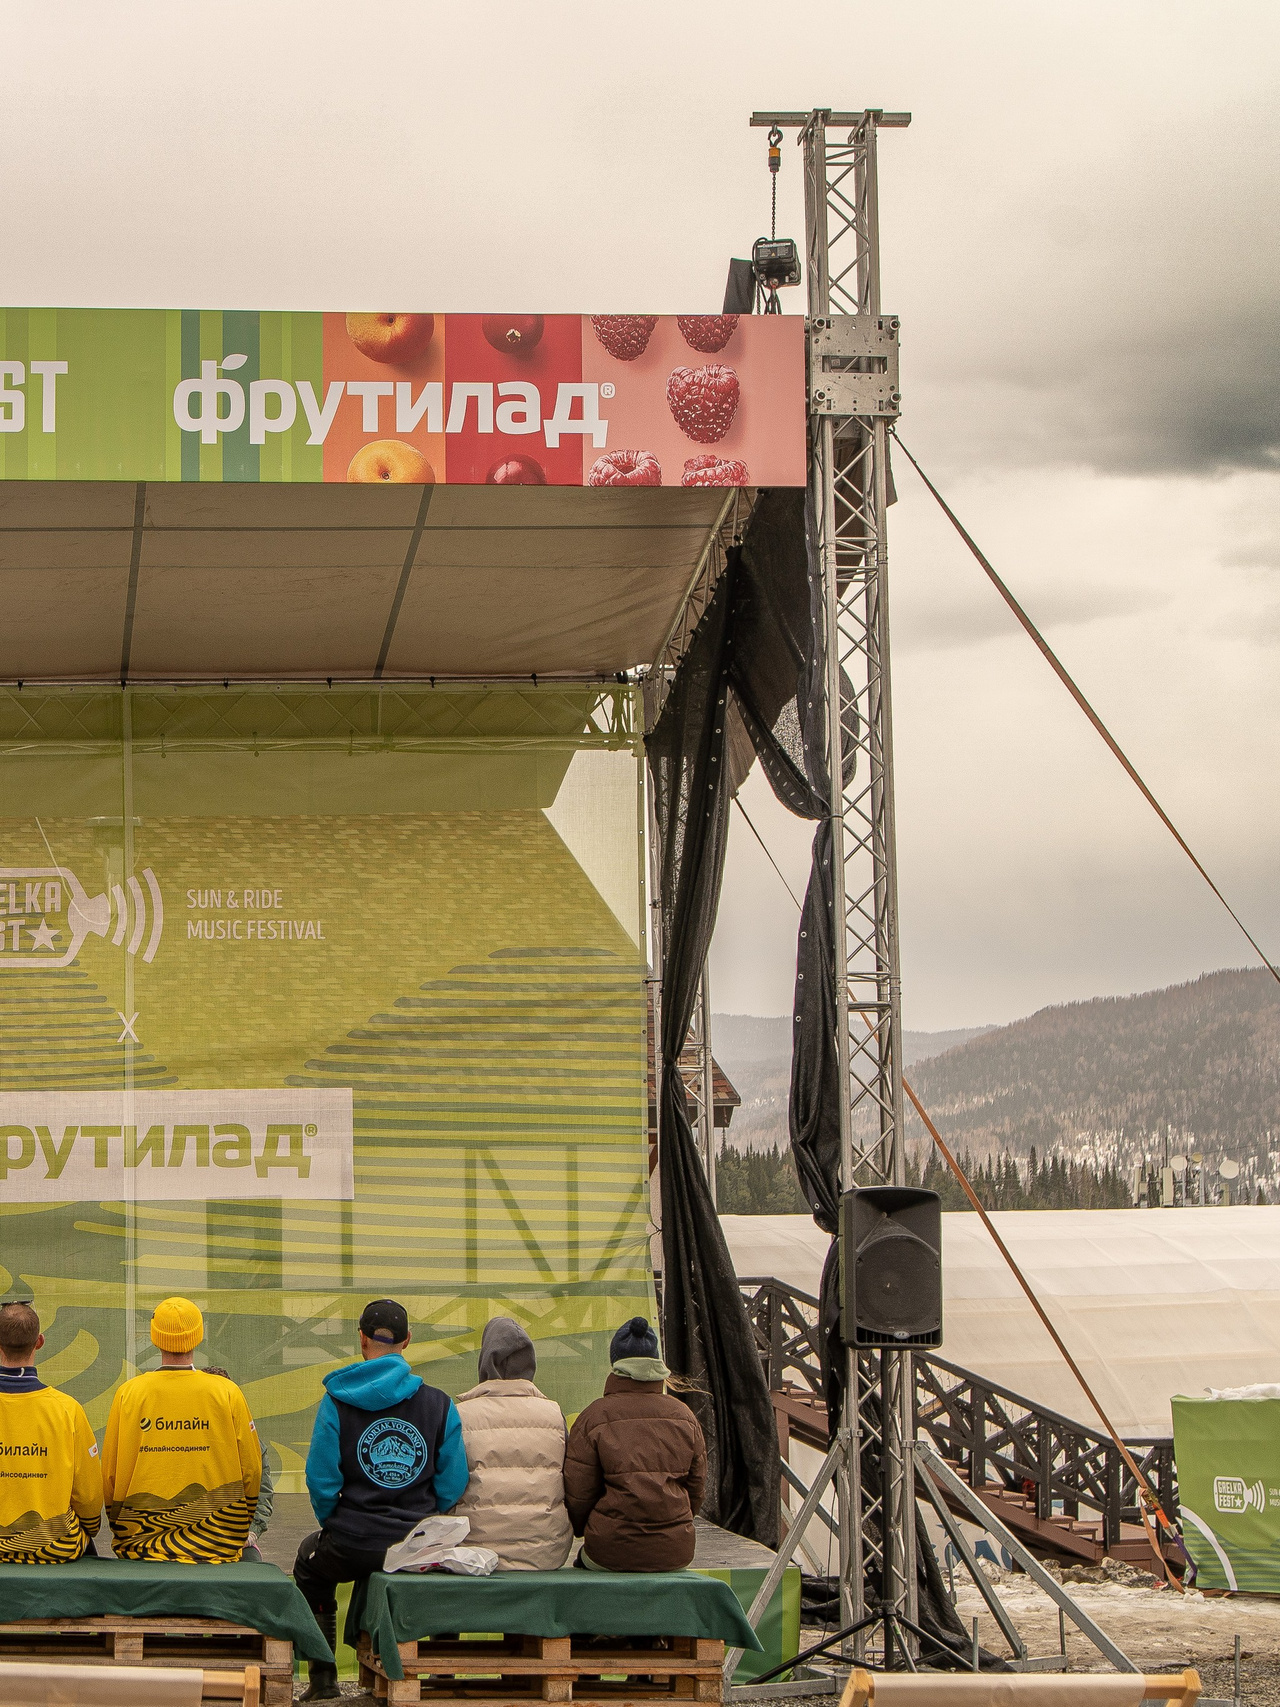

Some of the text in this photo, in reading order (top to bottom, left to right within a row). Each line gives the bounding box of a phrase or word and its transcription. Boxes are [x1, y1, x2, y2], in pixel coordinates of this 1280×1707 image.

[186, 889, 283, 909] SUN & RIDE
[187, 920, 326, 940] MUSIC FESTIVAL
[155, 1416, 210, 1431] билайн
[364, 1421, 391, 1445] KORYAK
[1218, 1481, 1243, 1494] GRELKA
[1220, 1495, 1235, 1507] FEST
